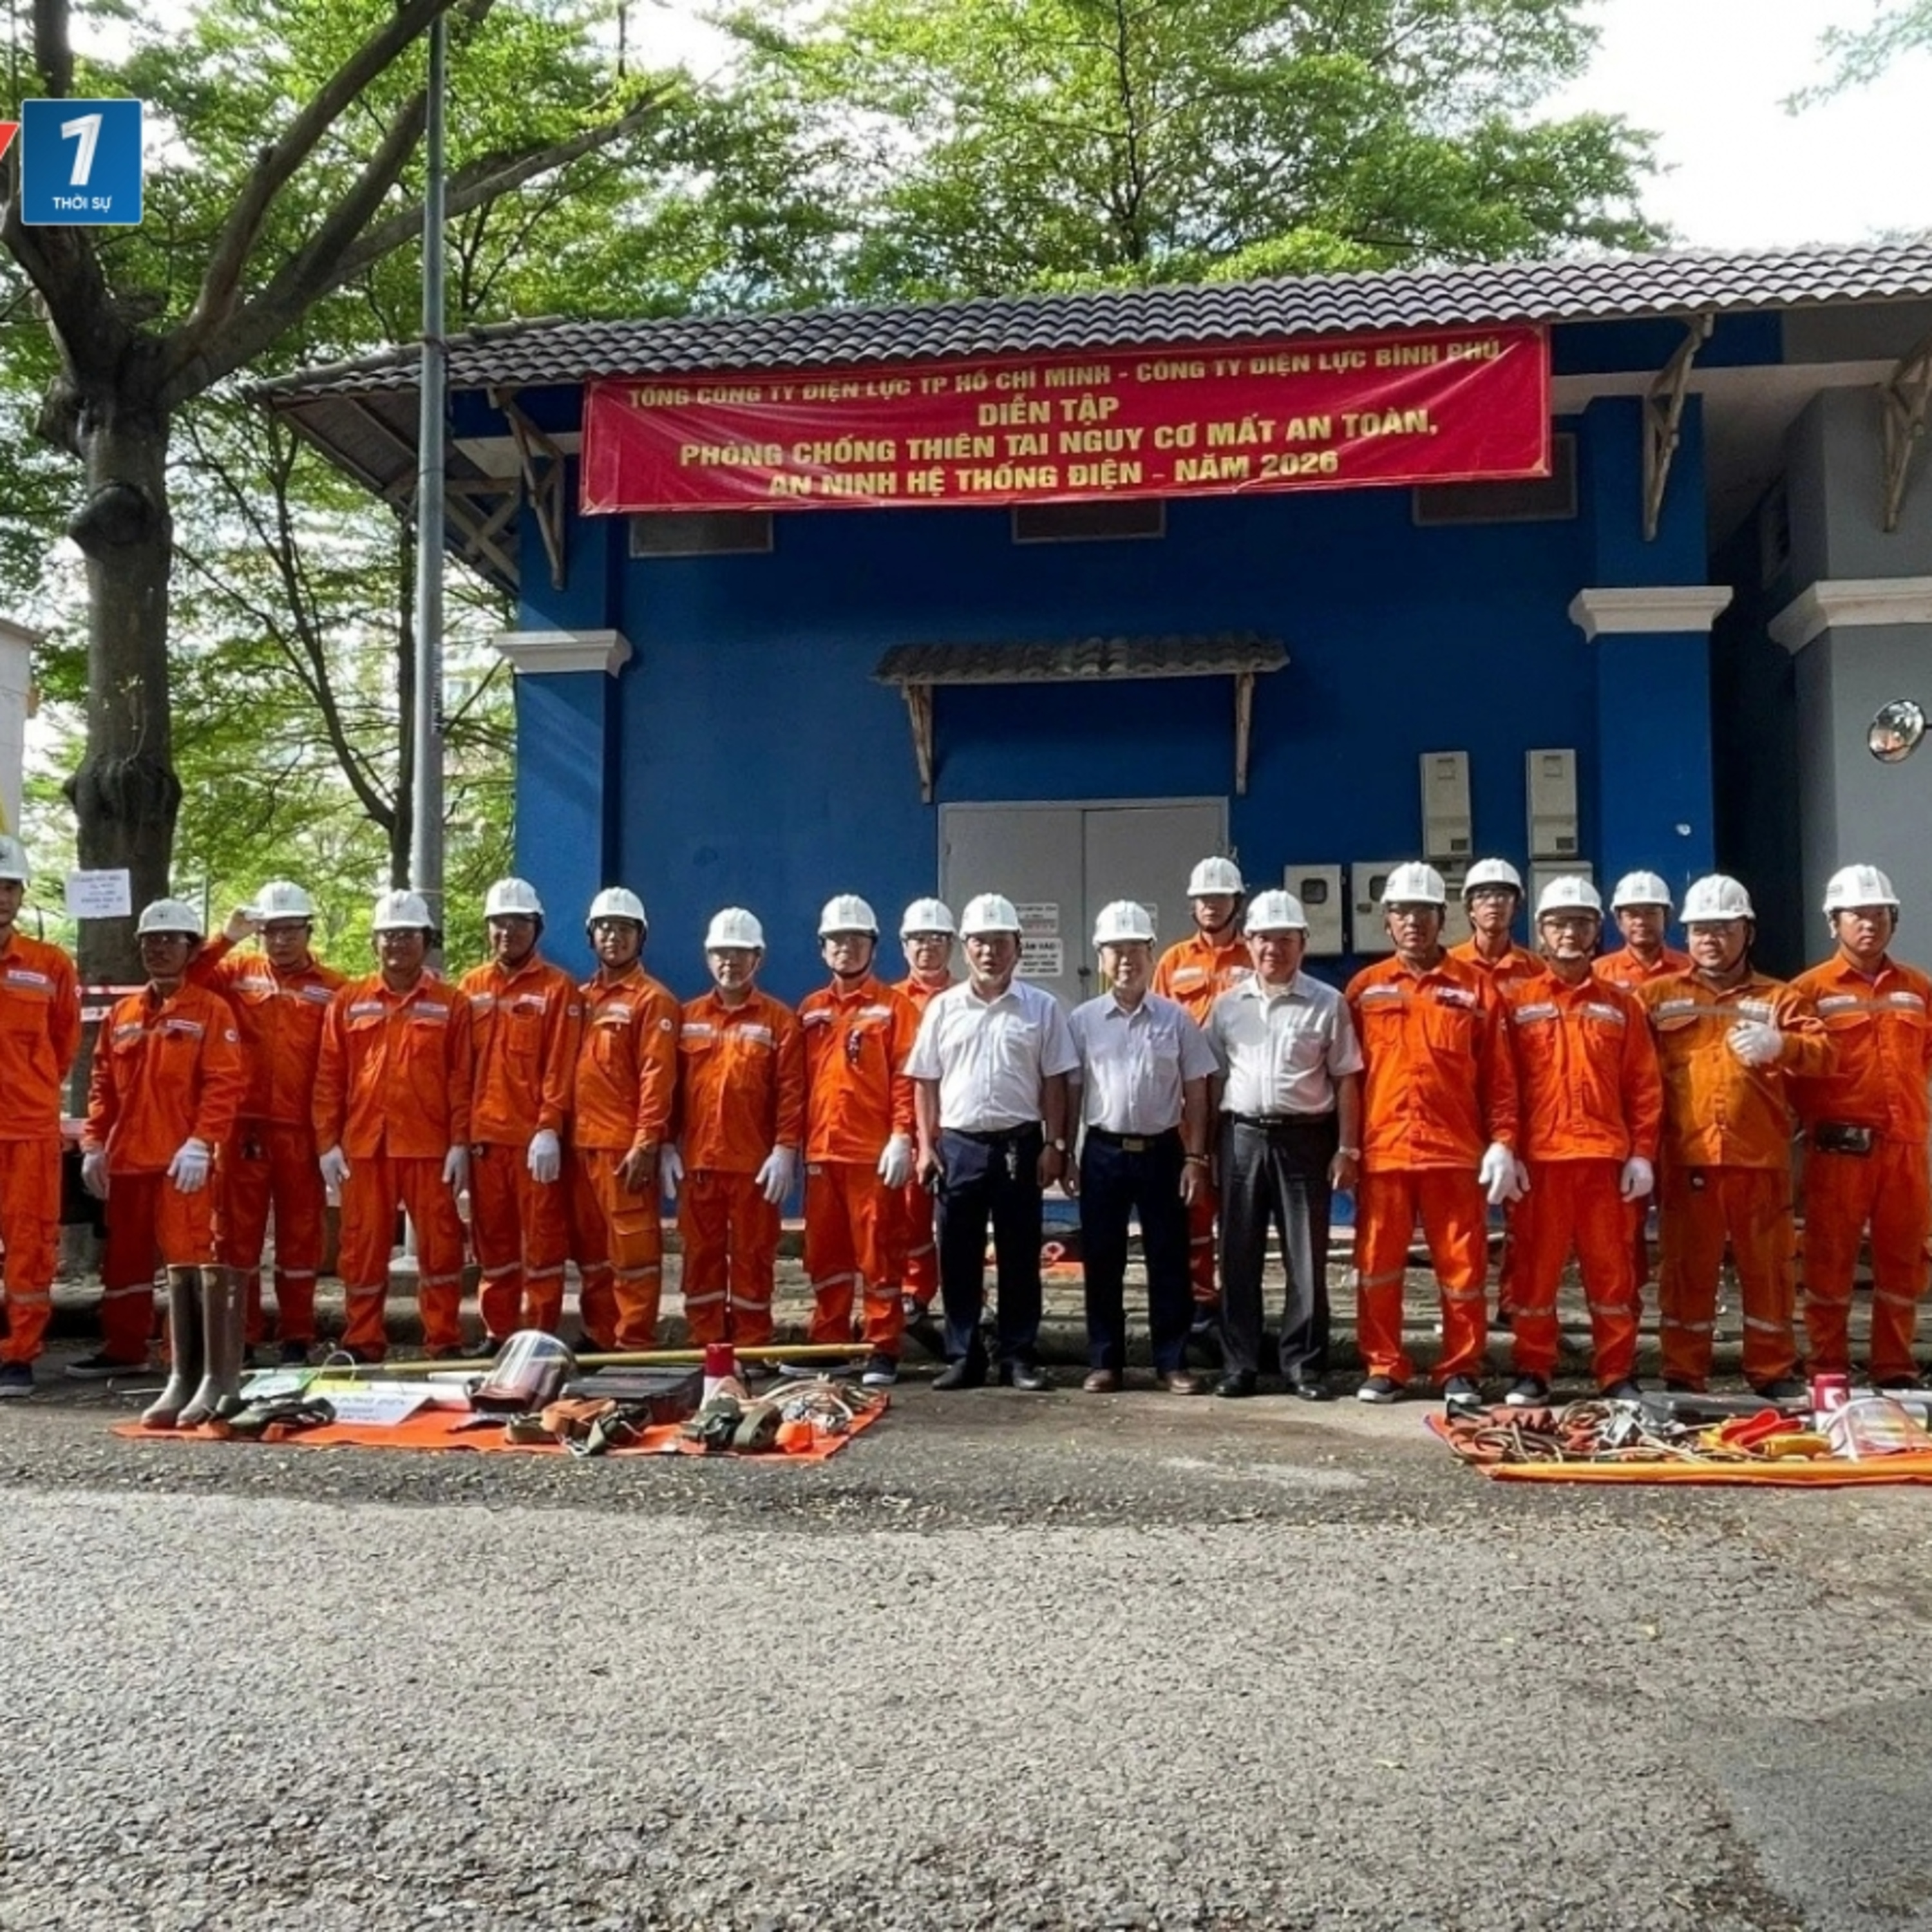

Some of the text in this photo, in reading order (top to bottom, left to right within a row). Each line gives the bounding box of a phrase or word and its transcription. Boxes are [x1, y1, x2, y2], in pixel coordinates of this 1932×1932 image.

[770, 384, 795, 401] TY
[866, 377, 911, 400] LỰC
[921, 376, 948, 393] TP
[1045, 364, 1111, 387] MINH
[1137, 358, 1205, 382] CÔNG
[1215, 359, 1241, 377] TY
[1249, 352, 1311, 377] ĐIỆN
[1319, 350, 1367, 374] LỰC
[978, 392, 1119, 426] DIỄN TẬP
[680, 406, 1439, 466] PHÒNG CHỐNG THIÊN TAI NGUY CƠ MẤT AN TOÀN,
[768, 475, 812, 497] AN
[820, 471, 898, 495] NINH
[907, 465, 945, 497] HỆ
[955, 460, 1058, 492] THỐNG
[1067, 459, 1142, 490] ĐIỆN
[1175, 452, 1250, 482] NĂM
[1260, 450, 1338, 479] 2026
